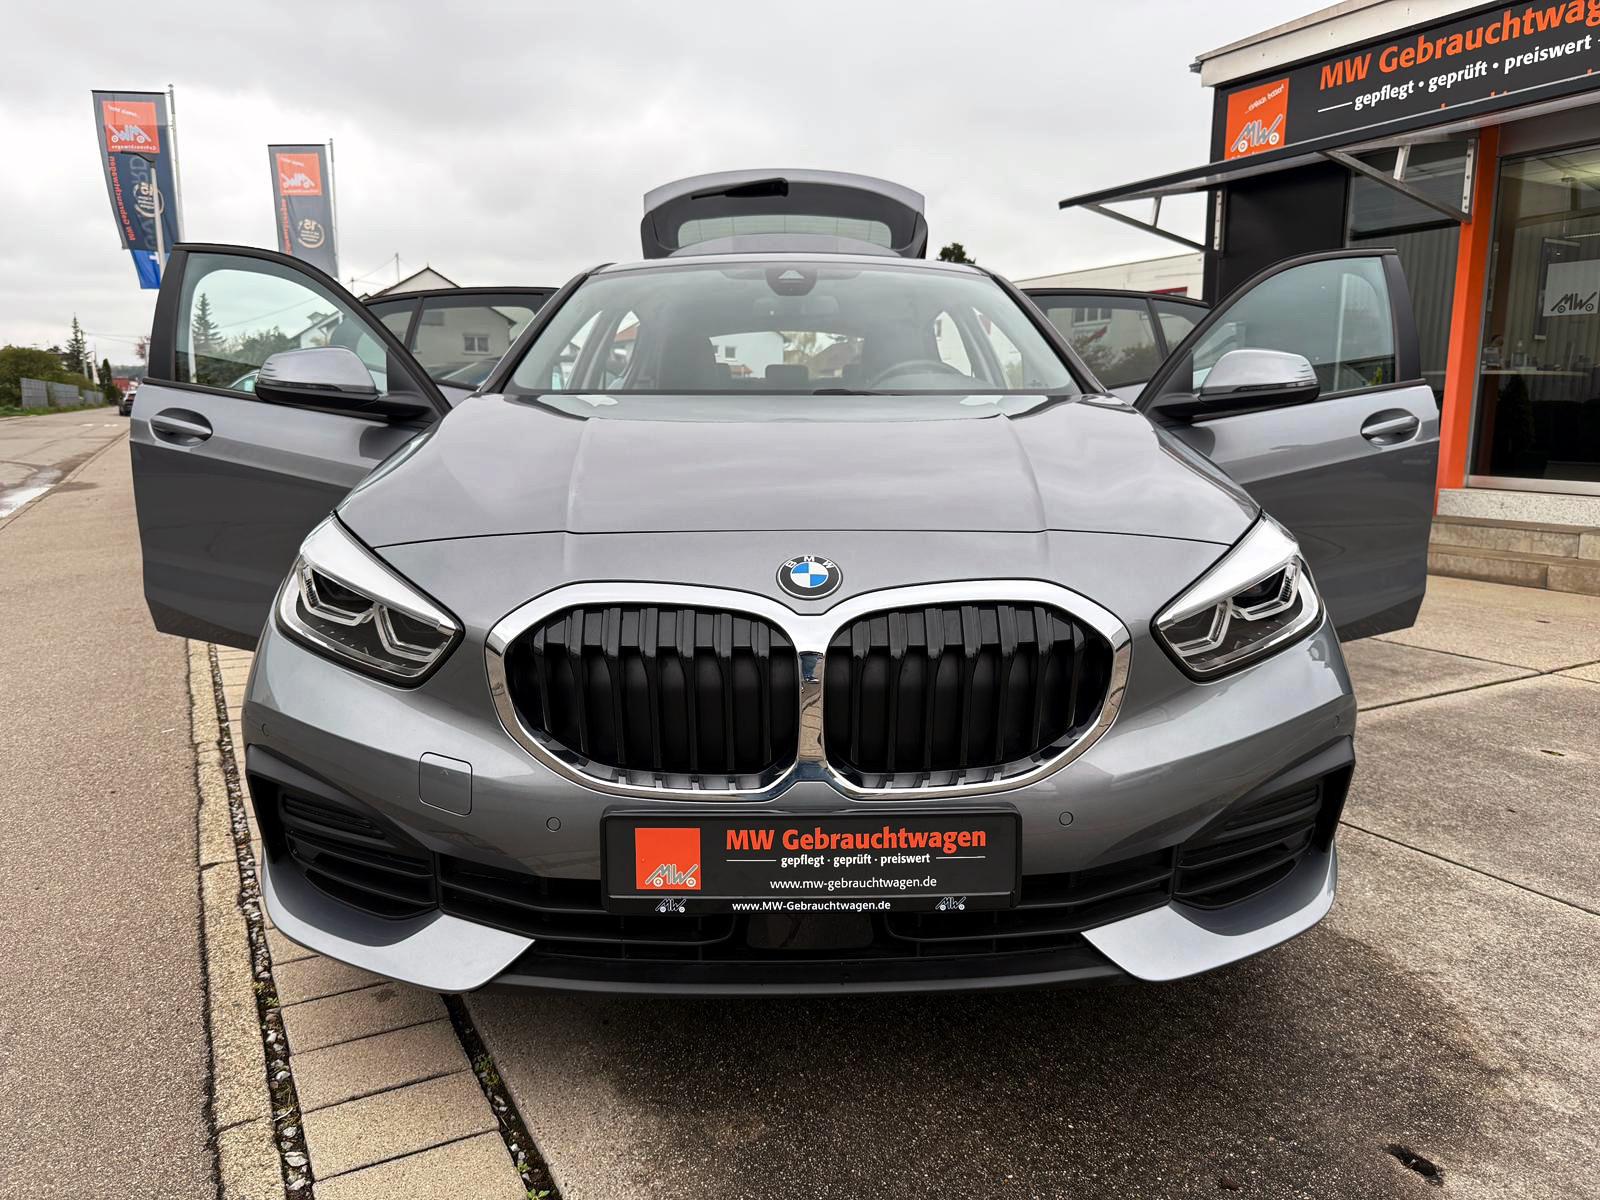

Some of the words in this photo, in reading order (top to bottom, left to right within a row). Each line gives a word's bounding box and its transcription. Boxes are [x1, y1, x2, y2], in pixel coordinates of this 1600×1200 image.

[1319, 53, 1372, 91] MW
[1354, 80, 1414, 111] gepflegt
[1428, 60, 1488, 93] geprüft
[1504, 34, 1592, 75] preiswert
[1551, 292, 1597, 313] MW
[785, 555, 835, 568] BMW
[726, 829, 775, 850] MW
[782, 826, 987, 854] Gebrauchtwagen
[781, 853, 825, 868] gepflegt
[833, 854, 872, 867] geprüft
[880, 853, 931, 866] preiswert
[645, 863, 699, 887] MW
[769, 876, 938, 891] www.mw-gebrauchtwagen.de
[732, 901, 891, 912] www.MW-Gebrauchtwagen.de
